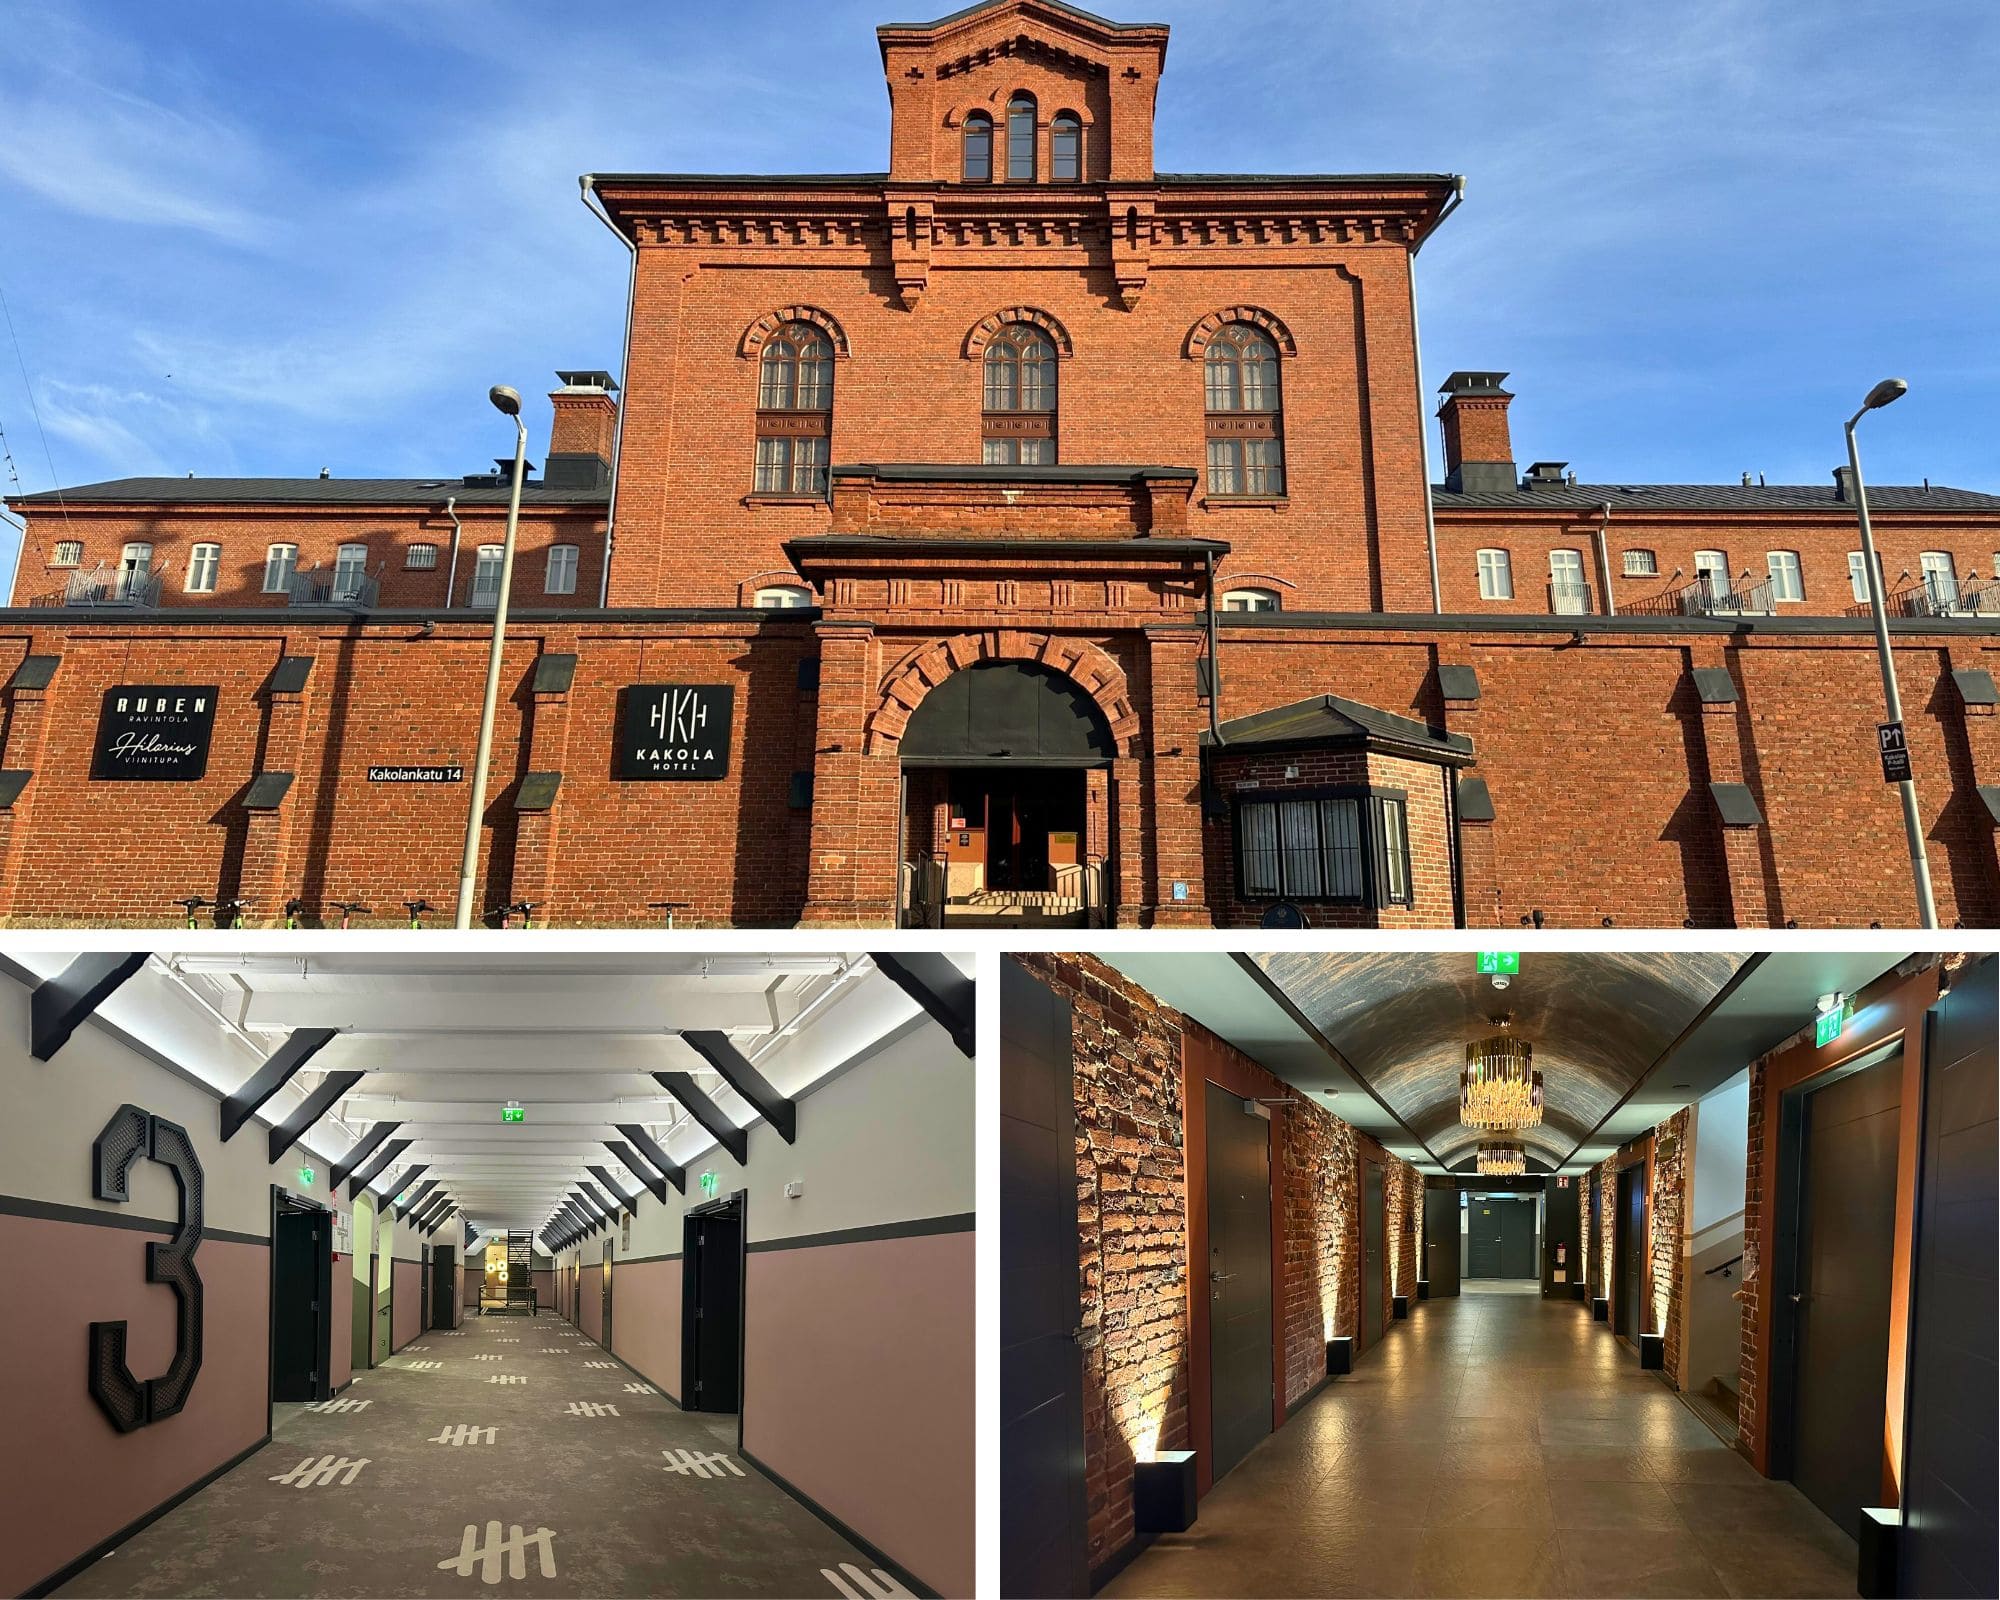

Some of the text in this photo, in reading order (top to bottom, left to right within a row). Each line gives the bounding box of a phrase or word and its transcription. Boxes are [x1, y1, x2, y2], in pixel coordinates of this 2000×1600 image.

[117, 698, 206, 713] RUBEN
[108, 732, 197, 759] Hilarius
[1880, 729, 1892, 748] P
[636, 749, 714, 760] KAKOLA
[369, 768, 461, 781] Kakolankatu 14
[653, 763, 697, 771] HOTEL
[88, 1103, 205, 1434] 3
